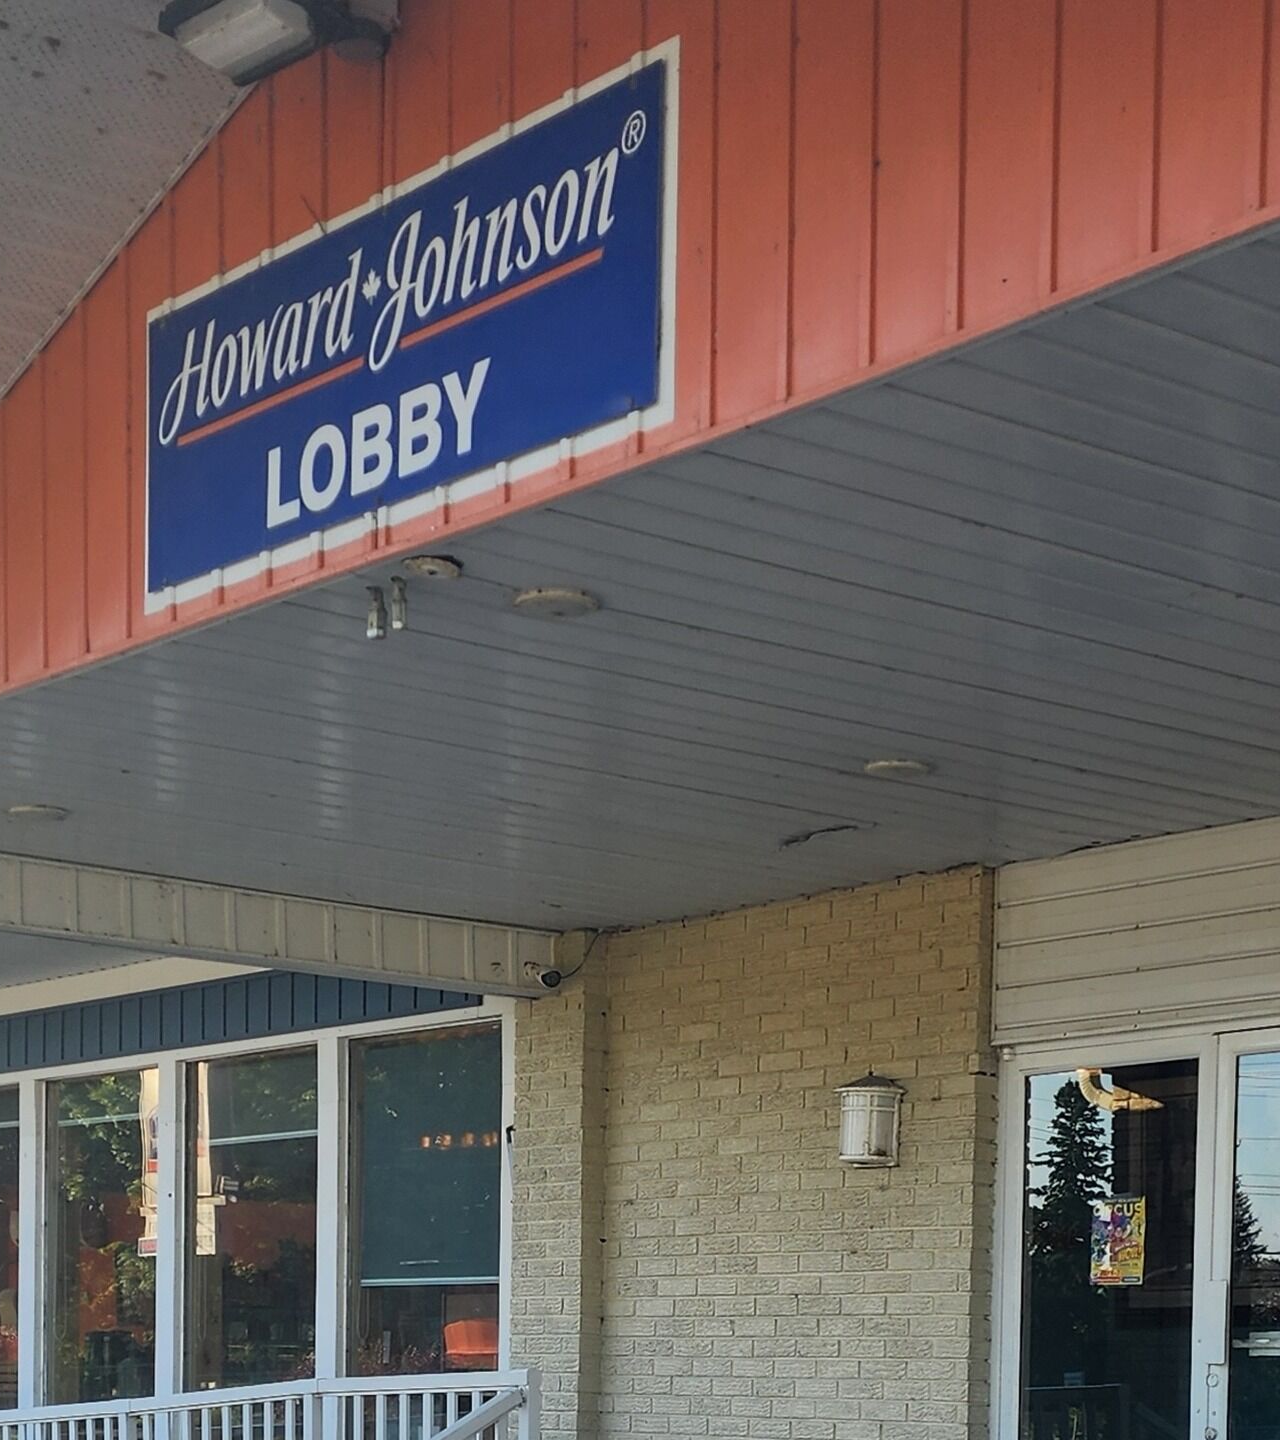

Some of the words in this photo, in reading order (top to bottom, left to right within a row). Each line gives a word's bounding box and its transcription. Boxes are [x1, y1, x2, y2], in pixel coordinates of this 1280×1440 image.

[159, 248, 362, 447] Howard
[266, 357, 491, 528] LOBBY
[1093, 1203, 1142, 1217] CCUS
